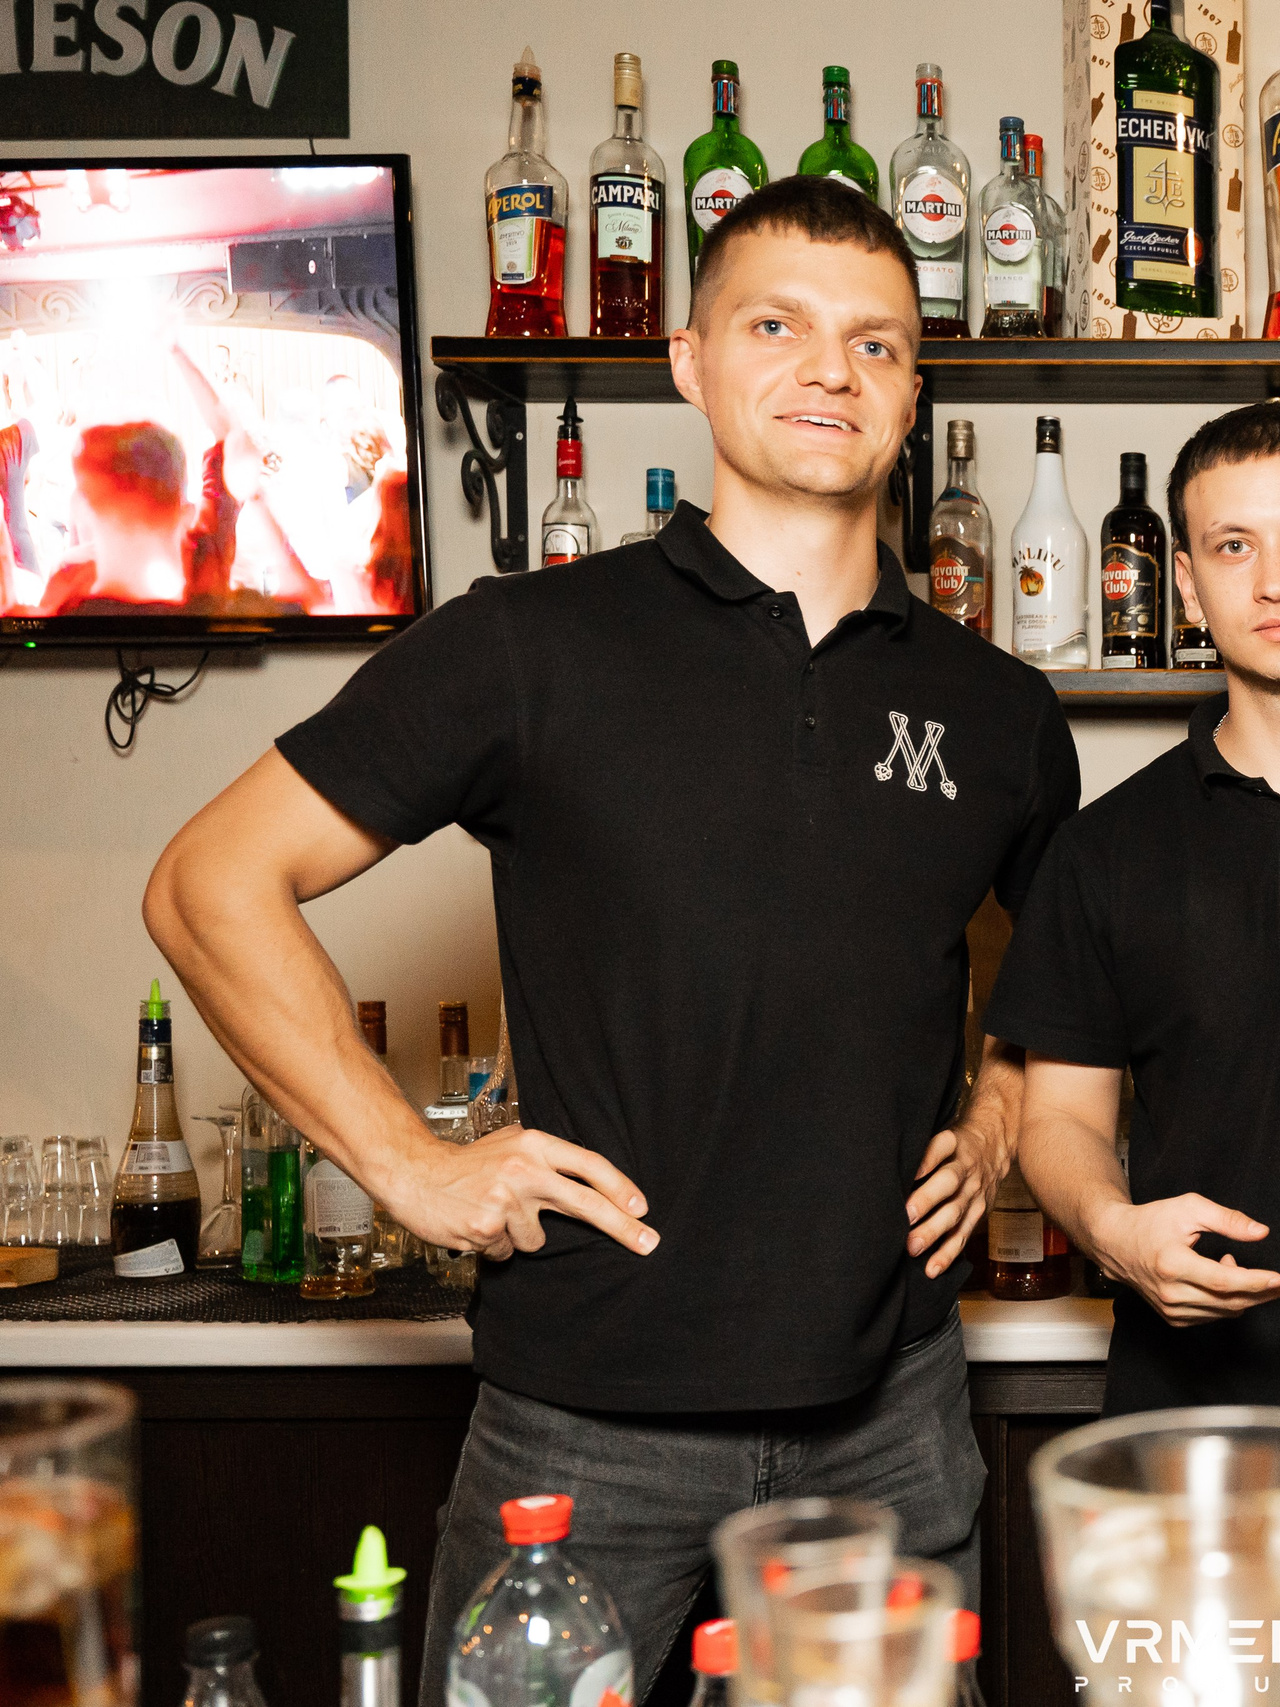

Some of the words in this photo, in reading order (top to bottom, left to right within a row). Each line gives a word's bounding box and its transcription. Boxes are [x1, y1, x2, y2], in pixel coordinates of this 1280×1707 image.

[1198, 4, 1222, 26] 1807
[0, 0, 296, 108] ESON
[1091, 55, 1111, 68] 807
[1117, 118, 1211, 150] ECHERVK
[1091, 138, 1116, 161] 1807
[592, 184, 660, 210] CAMPARI
[696, 197, 742, 210] MARTI
[488, 192, 545, 219] APEROL
[906, 201, 960, 216] MARTINI
[1091, 202, 1117, 217] 1807
[988, 230, 1031, 240] MARTINI
[1142, 232, 1180, 246] Becher
[1148, 246, 1180, 255] REPUBLIC
[1091, 288, 1117, 310] 1807
[1013, 547, 1065, 571] MALIBU
[935, 576, 959, 590] Club
[1105, 580, 1128, 594] Club
[1111, 611, 1121, 626] 7
